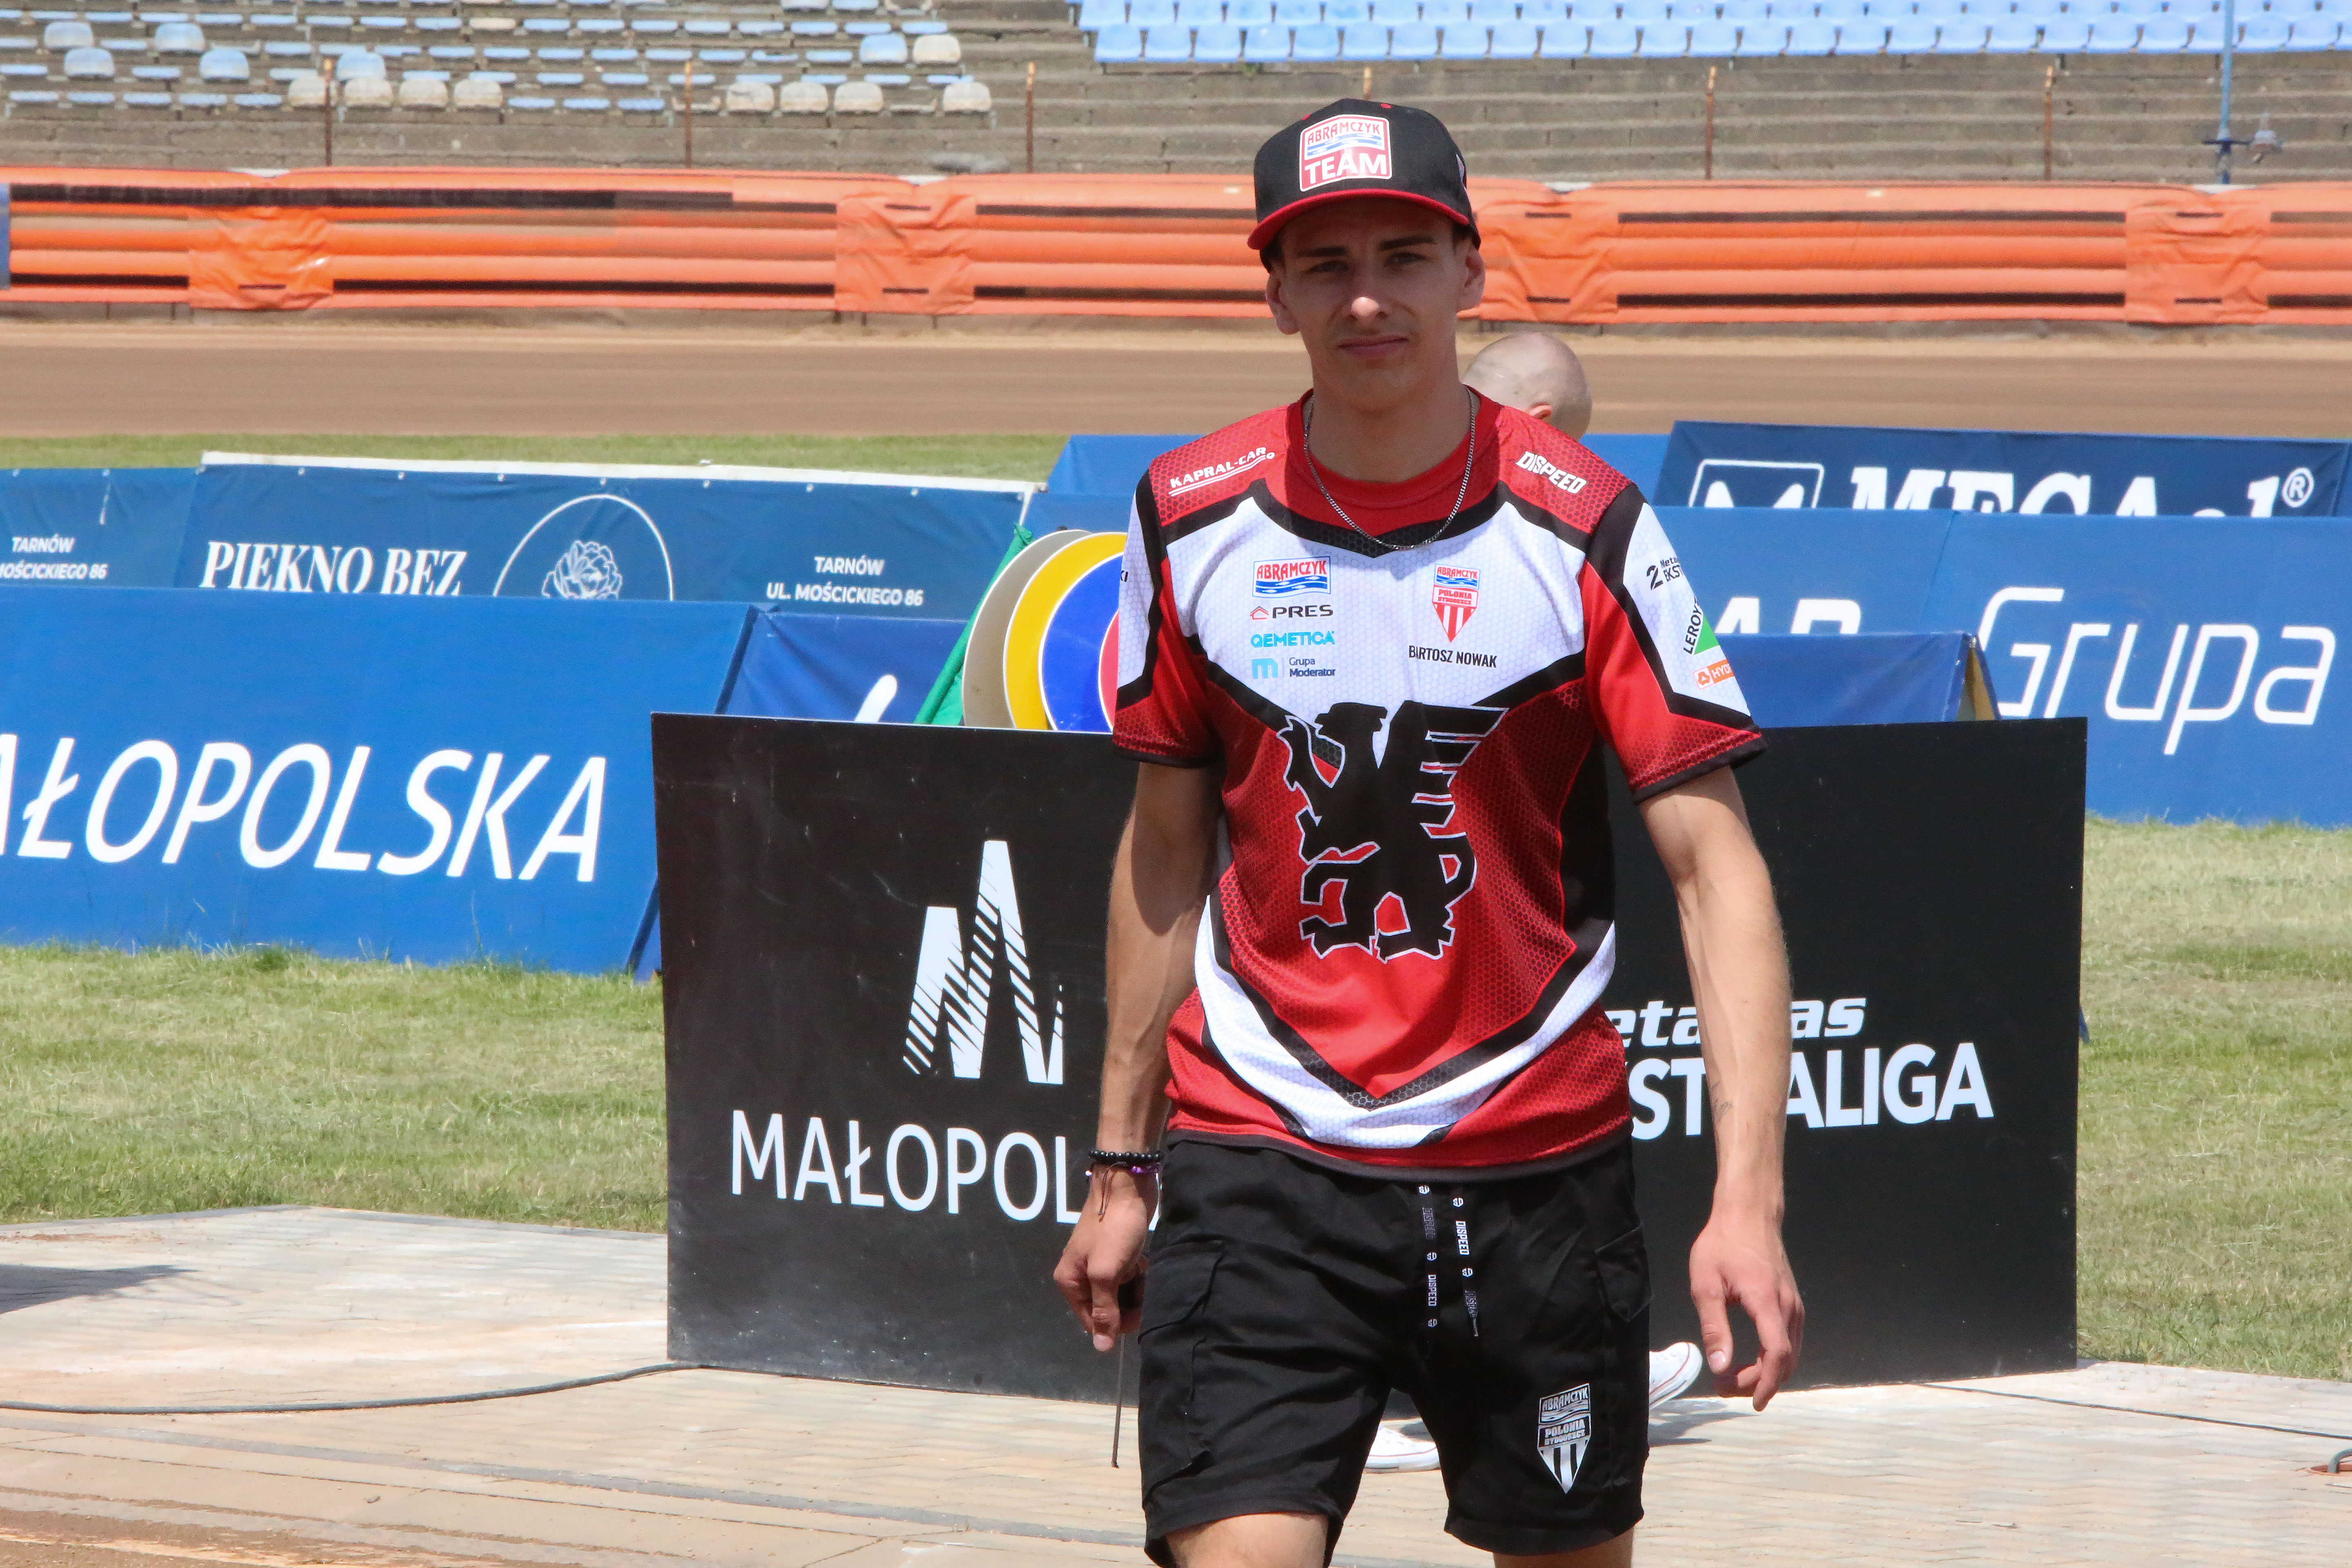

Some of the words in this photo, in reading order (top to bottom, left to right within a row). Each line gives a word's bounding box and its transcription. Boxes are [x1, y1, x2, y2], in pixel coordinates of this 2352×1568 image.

[1307, 122, 1380, 145] ABRAMCZYK
[1305, 153, 1387, 184] TEAM
[1170, 447, 1266, 488] KAPRAL-CAR
[1515, 451, 1588, 494] DISPEED
[12, 532, 76, 553] TARNÓW
[89, 563, 109, 579] 86
[380, 548, 466, 596] BEZ
[814, 555, 885, 576] TARNÓW
[1256, 561, 1327, 581] ABRAMCZYK
[1437, 566, 1478, 579] ABRAMCZYK
[1646, 565, 1664, 590] 2
[766, 581, 792, 599] UL.
[795, 581, 903, 606] MOŚCICKIEGO
[904, 589, 924, 606] 86
[1439, 589, 1472, 599] POLONIA
[1272, 604, 1334, 619] PRES
[1250, 630, 1336, 648] QEMETICA
[1683, 604, 1703, 654] LEROY
[1289, 657, 1316, 667] Grupa
[1456, 652, 1497, 668] NOWAK
[1977, 586, 2336, 755] Grupa
[1289, 668, 1336, 677] Moderator
[731, 1109, 1081, 1226] MAŁOPOL
[1455, 1220, 1470, 1256] DISPEED
[1542, 1387, 1588, 1411] ABRAMCZYK
[1545, 1419, 1585, 1438] POLONIA
